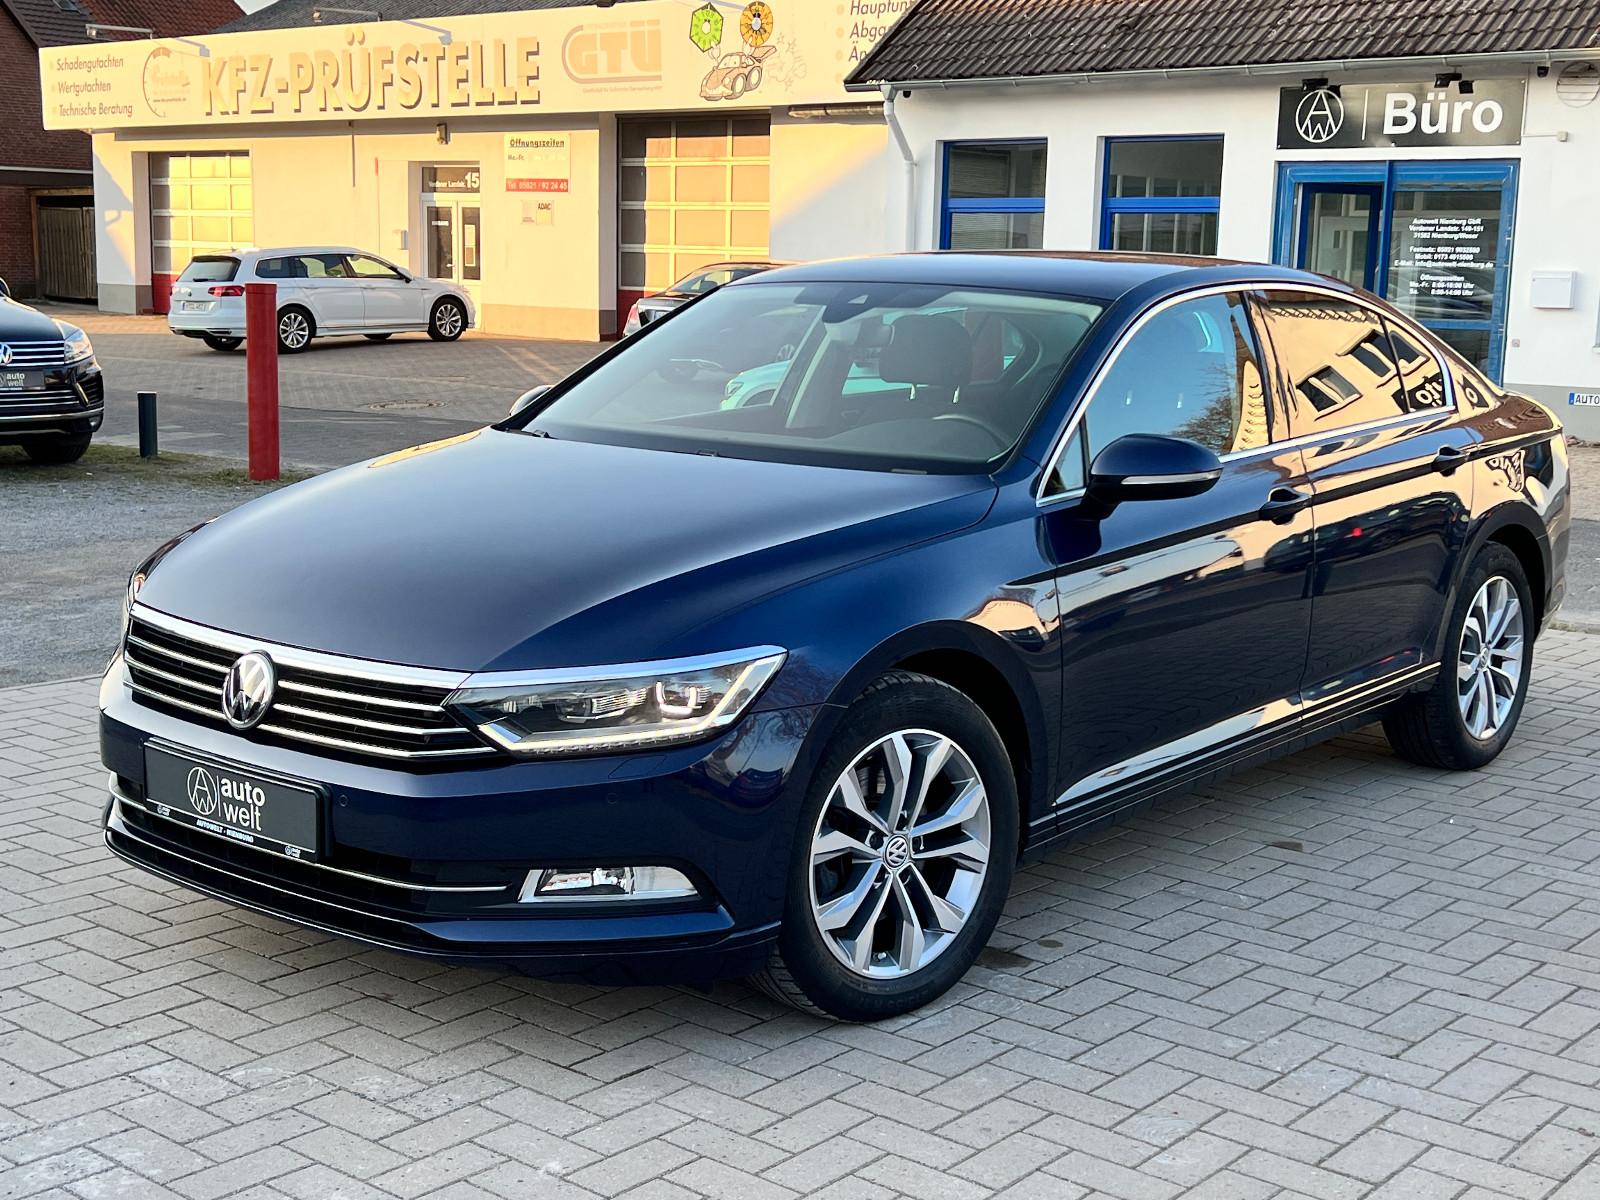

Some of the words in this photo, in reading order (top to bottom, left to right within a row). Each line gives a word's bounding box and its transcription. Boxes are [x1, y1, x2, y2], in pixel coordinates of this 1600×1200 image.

[850, 0, 913, 19] Hauptun
[850, 20, 887, 42] Abga
[569, 19, 661, 75] GTÜ
[848, 41, 867, 62] Än
[57, 54, 124, 73] Schadengutachten
[203, 27, 541, 116] KFZ-PRÜFSTELLE
[58, 78, 111, 96] Wertgutachten
[59, 102, 97, 116] Technische
[98, 102, 133, 117] Beratung
[1384, 92, 1503, 135] Büro
[510, 137, 565, 148] Öffnungszeiten
[465, 171, 480, 188] 15
[560, 182, 568, 190] 45
[1440, 217, 1467, 226] Nienburg
[1575, 394, 1600, 405] AUTO
[221, 778, 266, 807] auto
[223, 801, 262, 831] welt
